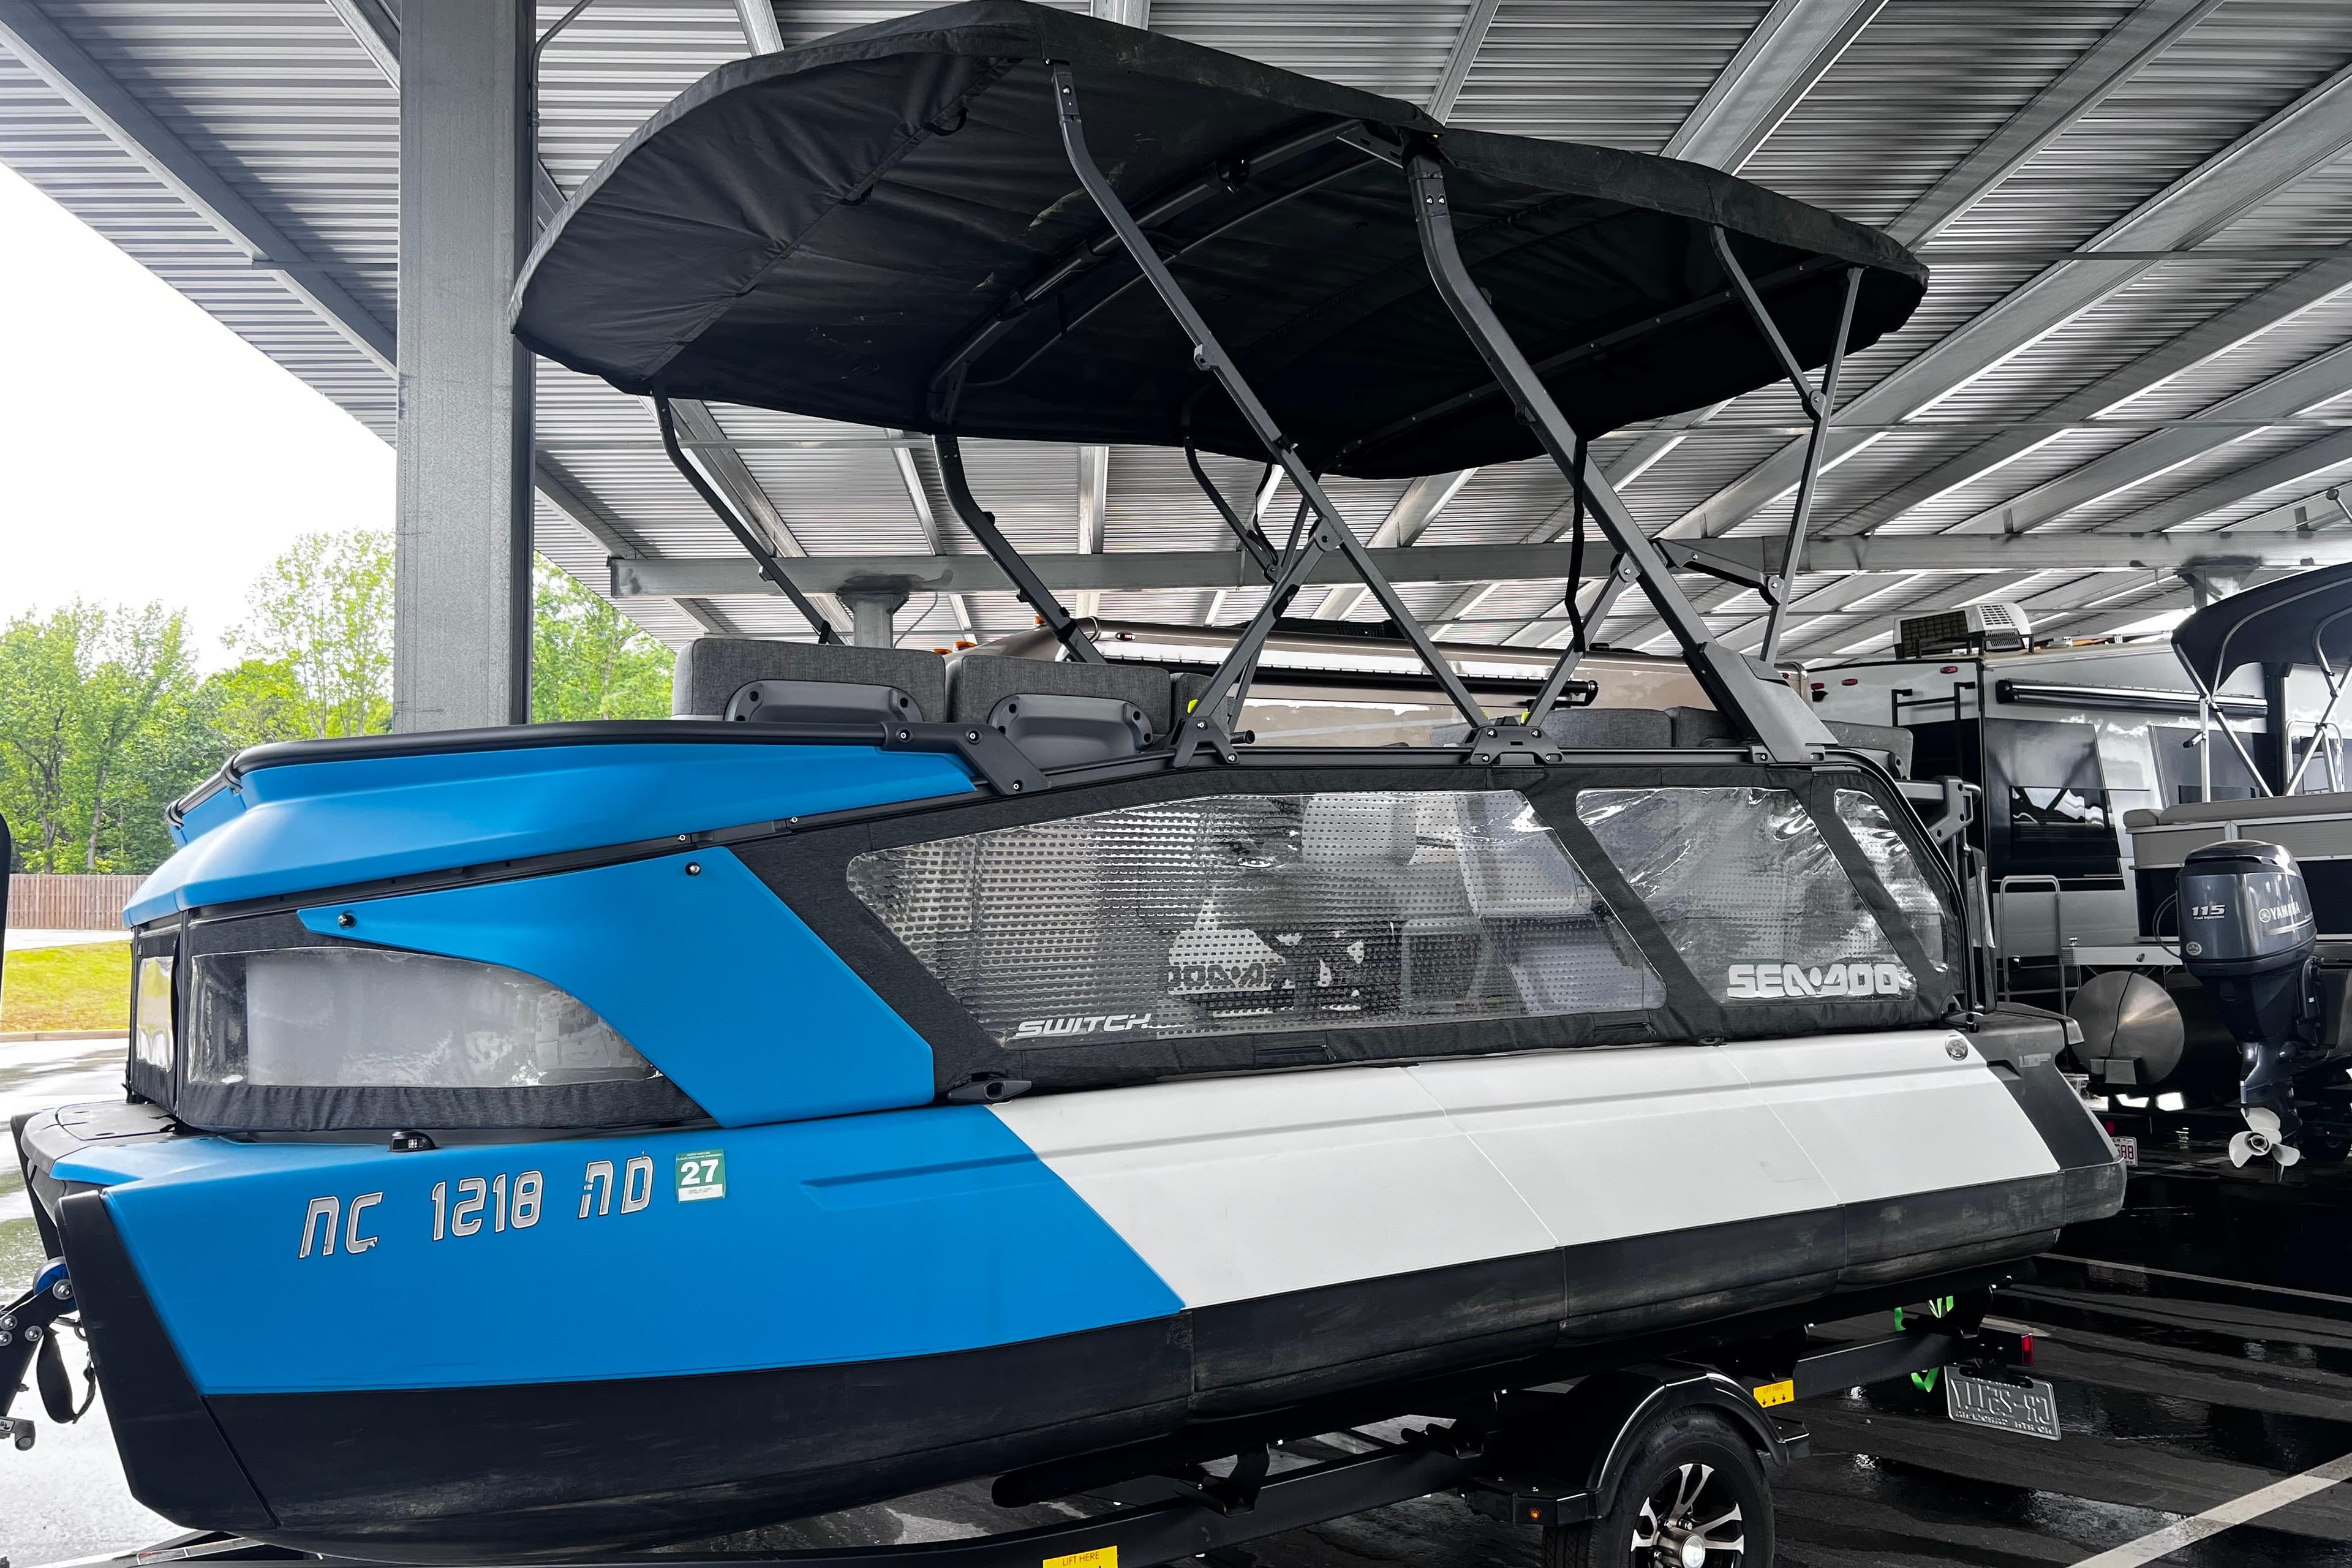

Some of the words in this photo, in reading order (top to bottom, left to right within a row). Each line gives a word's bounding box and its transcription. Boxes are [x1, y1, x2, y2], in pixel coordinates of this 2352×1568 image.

[2192, 905, 2225, 916] 115
[2270, 902, 2301, 920] YAMAHA
[1016, 1013, 1152, 1039] SWITCH
[680, 1159, 719, 1186] 27
[298, 1191, 384, 1260] NC
[431, 1170, 544, 1242] 1218
[578, 1155, 654, 1220] ND
[1063, 1556, 1077, 1566] LIFT
[1079, 1551, 1100, 1561] HERE
